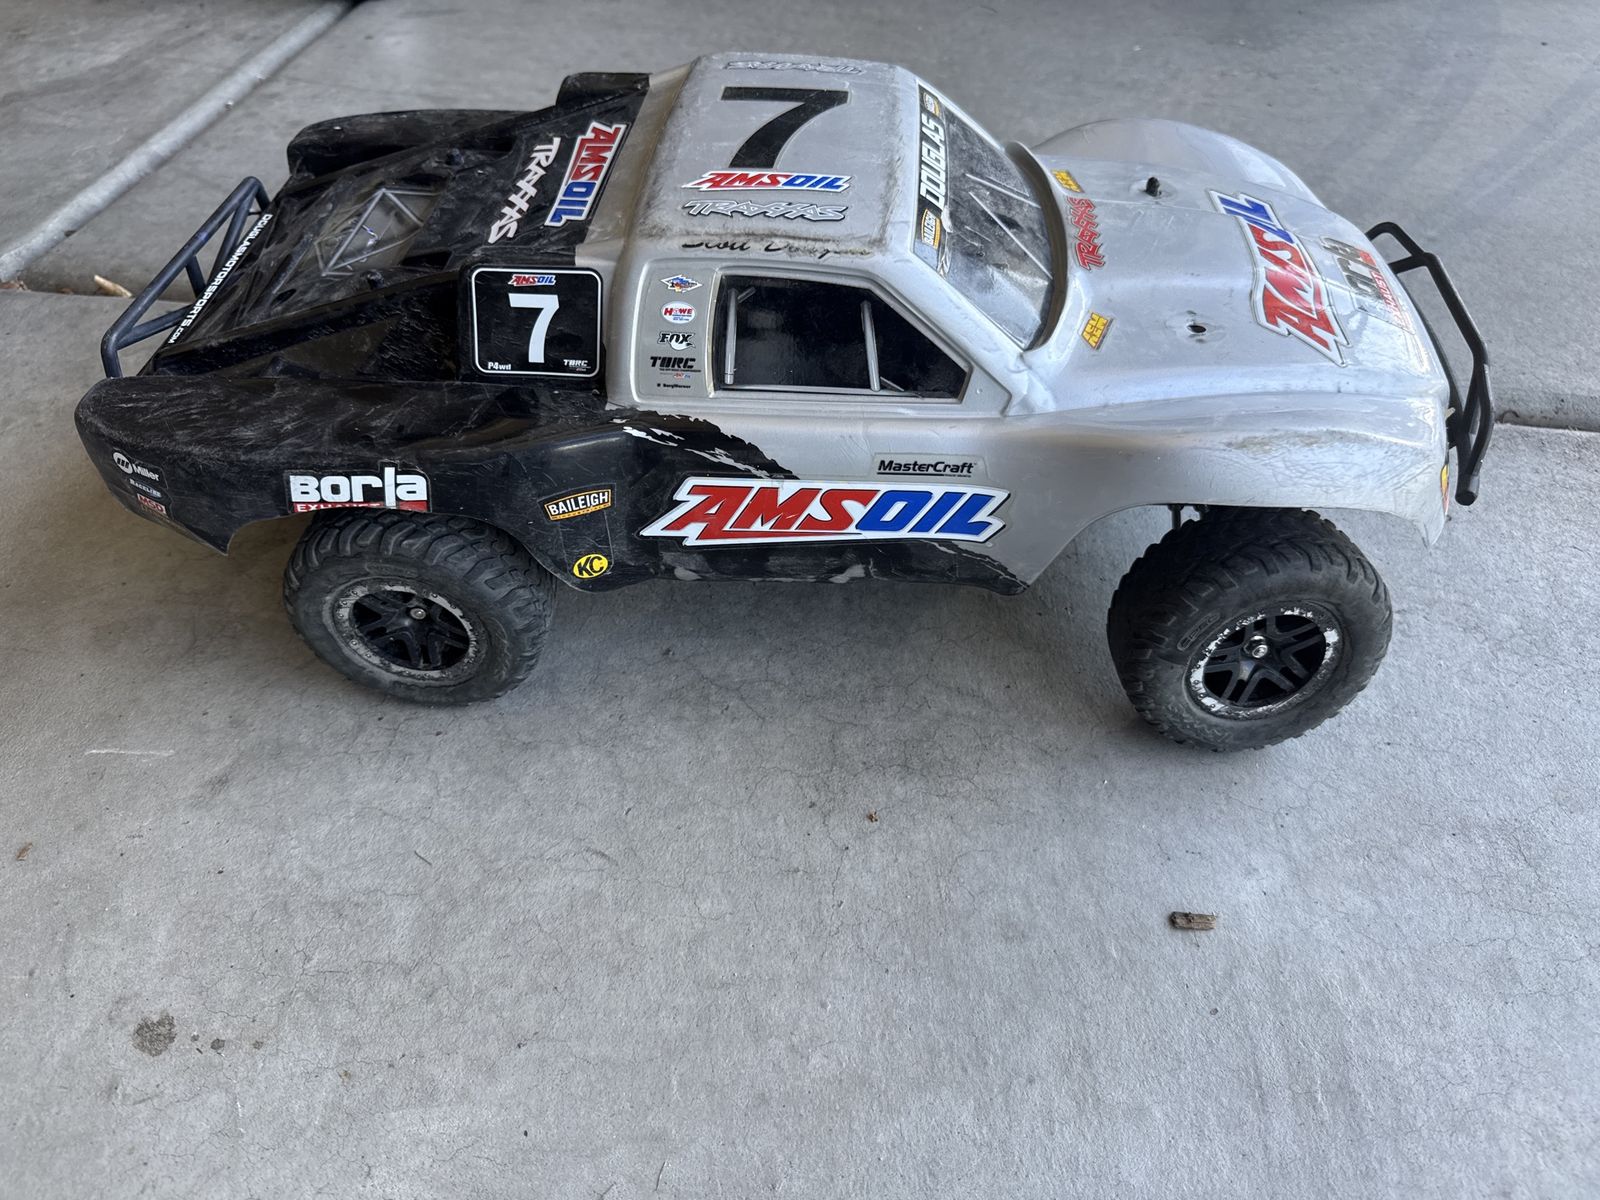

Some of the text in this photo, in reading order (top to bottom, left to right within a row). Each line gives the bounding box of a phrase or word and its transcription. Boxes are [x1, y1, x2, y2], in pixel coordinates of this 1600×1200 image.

[721, 86, 849, 168] 7
[550, 126, 621, 222] AMSOIL
[920, 113, 946, 211] DOUGLAS
[488, 137, 561, 243] TRAXXAS
[694, 173, 848, 190] AMSOIL
[683, 200, 849, 221] TRAXXAS
[511, 275, 555, 285] AMSOIL
[508, 293, 560, 363] 7
[132, 463, 160, 481] Miller
[878, 460, 974, 474] MasterCraft
[548, 491, 609, 516] BAILEIGH
[661, 485, 996, 540] AMSOIL
[577, 556, 604, 576] KC
